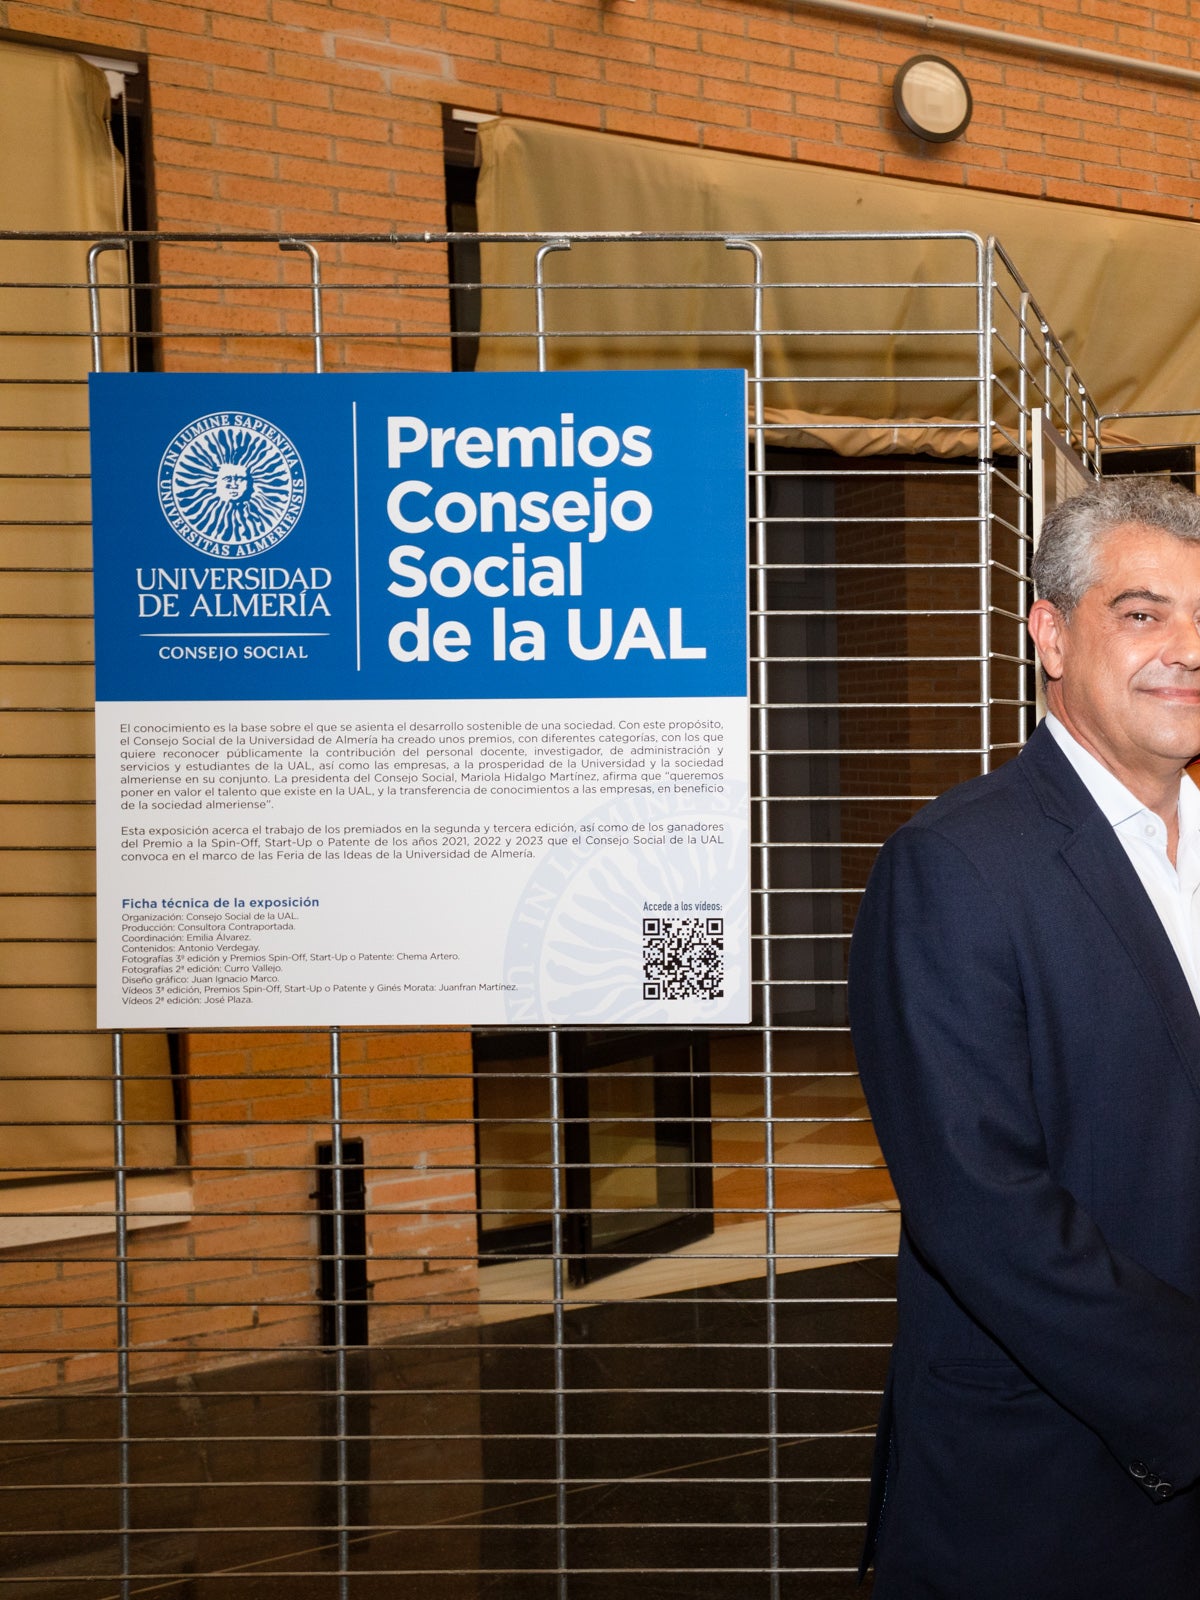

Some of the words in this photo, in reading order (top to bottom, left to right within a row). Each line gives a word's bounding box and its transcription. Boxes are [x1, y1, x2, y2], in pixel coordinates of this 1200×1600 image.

[165, 451, 178, 467] IN
[175, 415, 230, 449] LUMINE
[234, 414, 299, 467] SAPIENTIA
[388, 413, 652, 468] Premios
[160, 479, 230, 556] UNIVERSITAS
[236, 479, 304, 556] ALMERIENSIS
[387, 478, 652, 543] Consejo
[388, 542, 582, 597] Social
[137, 568, 331, 591] UNIVERSIDAD
[138, 594, 180, 618] DE
[190, 589, 331, 617] ALMERÍA
[389, 607, 471, 662] de
[494, 607, 545, 662] la
[568, 607, 706, 661] UAL
[159, 647, 237, 661] CONSEJO
[244, 646, 308, 659] SOCIAL
[120, 723, 131, 733] El
[133, 724, 211, 733] conocimiento
[228, 723, 238, 732] la
[241, 723, 267, 732] base
[270, 723, 301, 732] sobre
[304, 723, 314, 732] el
[316, 724, 338, 733] que
[340, 724, 352, 732] se
[354, 723, 394, 732] asienta
[397, 722, 406, 731] el
[409, 722, 464, 731] desarrollo
[466, 721, 522, 731] sostenible
[524, 721, 539, 730] de
[564, 720, 616, 730] sociedad.
[618, 720, 640, 730] Con
[642, 721, 666, 729] este
[668, 720, 724, 730] propósito,
[120, 750, 156, 760] quiere
[226, 748, 303, 759] públicamente
[309, 748, 319, 757] la
[325, 748, 396, 757] contribución
[402, 748, 419, 757] del
[426, 747, 473, 758] personal
[480, 747, 527, 756] docente,
[534, 746, 603, 757] investigador,
[609, 746, 624, 755] de
[630, 745, 710, 755] administración
[717, 747, 724, 756] y
[120, 775, 182, 784] almeriense
[185, 776, 199, 784] en
[202, 776, 215, 784] su
[218, 775, 270, 785] conjunto.
[274, 774, 288, 783] La
[291, 774, 350, 784] presidenta
[353, 773, 370, 783] del
[374, 773, 419, 784] Consejo
[421, 773, 457, 782] Social,
[461, 772, 501, 782] Mariola
[504, 772, 547, 783] Hidalgo
[550, 772, 599, 781] Martínez,
[602, 771, 638, 781] afirma
[640, 773, 662, 782] que
[121, 839, 138, 848] del
[142, 839, 183, 848] Premio
[186, 840, 194, 848] a
[197, 838, 207, 848] la
[211, 838, 261, 849] Spin-Off,
[264, 838, 313, 848] Start-Up
[328, 837, 371, 847] Patente
[374, 837, 389, 846] de
[392, 837, 408, 846] los
[412, 837, 438, 846] años
[442, 836, 470, 846] 2021,
[473, 836, 501, 846] 2022
[505, 838, 512, 847] y
[515, 836, 544, 846] 2023
[547, 838, 568, 846] que
[572, 836, 582, 845] el
[585, 835, 630, 846] Consejo
[632, 835, 666, 845] Social
[669, 835, 684, 844] de
[687, 835, 697, 844] la
[700, 835, 725, 844] UAL
[122, 898, 158, 909] Ficha
[161, 898, 210, 908] técnica
[213, 898, 230, 908] de
[234, 898, 245, 908] la
[249, 897, 320, 909] exposición
[642, 901, 672, 911] Accede
[674, 903, 679, 911] a
[680, 901, 693, 911] los
[694, 901, 723, 911] vídeos:
[121, 913, 184, 922] Organización:
[186, 913, 223, 922] Consejo
[224, 912, 252, 920] Social
[253, 912, 266, 920] de
[267, 912, 276, 920] la
[277, 912, 299, 920] UAL.
[121, 934, 184, 942] Coordinación:
[186, 934, 214, 942] Emilia
[215, 933, 252, 941] Álvarez.
[121, 965, 174, 975] Fotografías
[186, 965, 222, 973] edición:
[224, 964, 250, 972] Curro
[251, 964, 283, 973] Vallejo.
